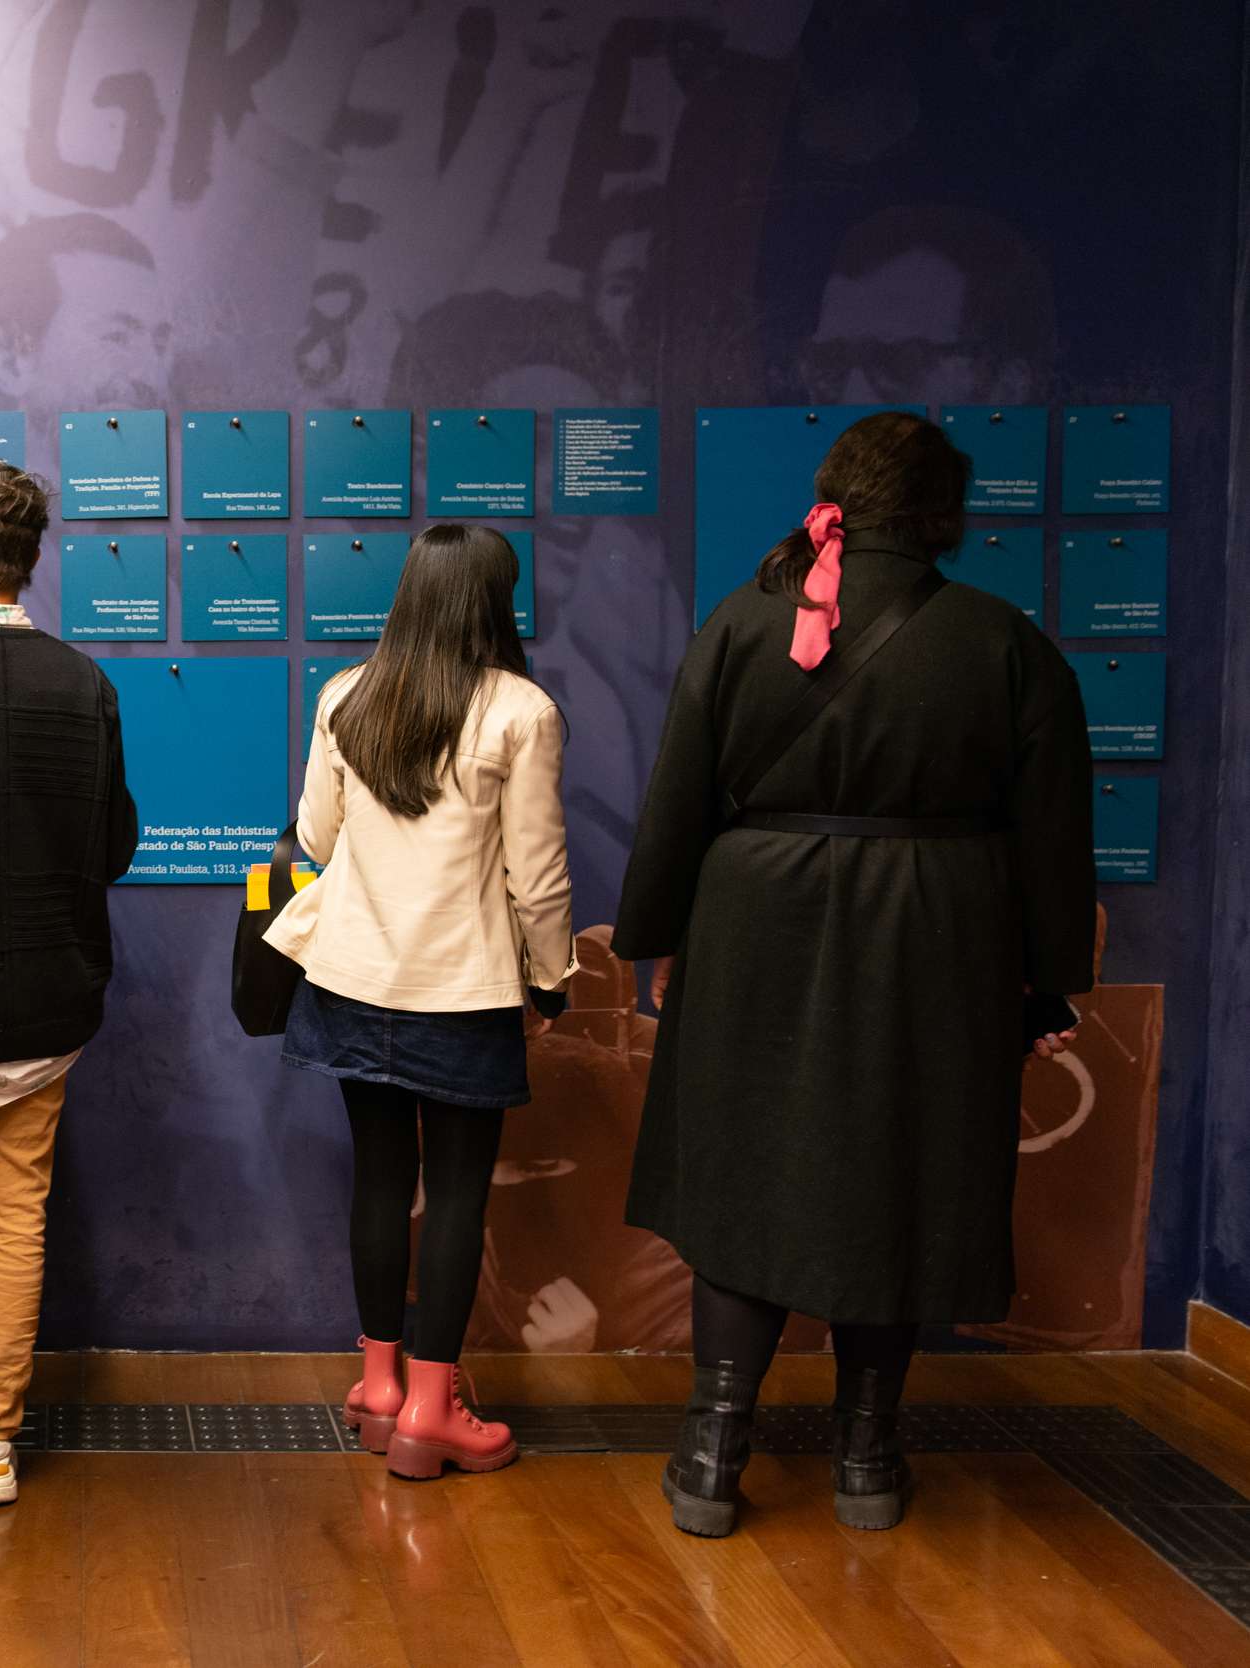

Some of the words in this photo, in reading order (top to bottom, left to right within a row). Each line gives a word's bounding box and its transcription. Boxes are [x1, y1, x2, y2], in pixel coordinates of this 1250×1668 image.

[126, 483, 160, 491] Propriedade
[348, 612, 374, 620] Feminina
[144, 826, 200, 838] Federação
[202, 826, 221, 838] das
[223, 826, 277, 838] Indústrias
[136, 841, 168, 852] stado
[170, 841, 184, 852] de
[186, 841, 206, 852] São
[208, 841, 239, 852] Paulo
[127, 864, 167, 875] Avenida
[168, 864, 210, 875] Paulista,
[211, 864, 238, 875] 1313,
